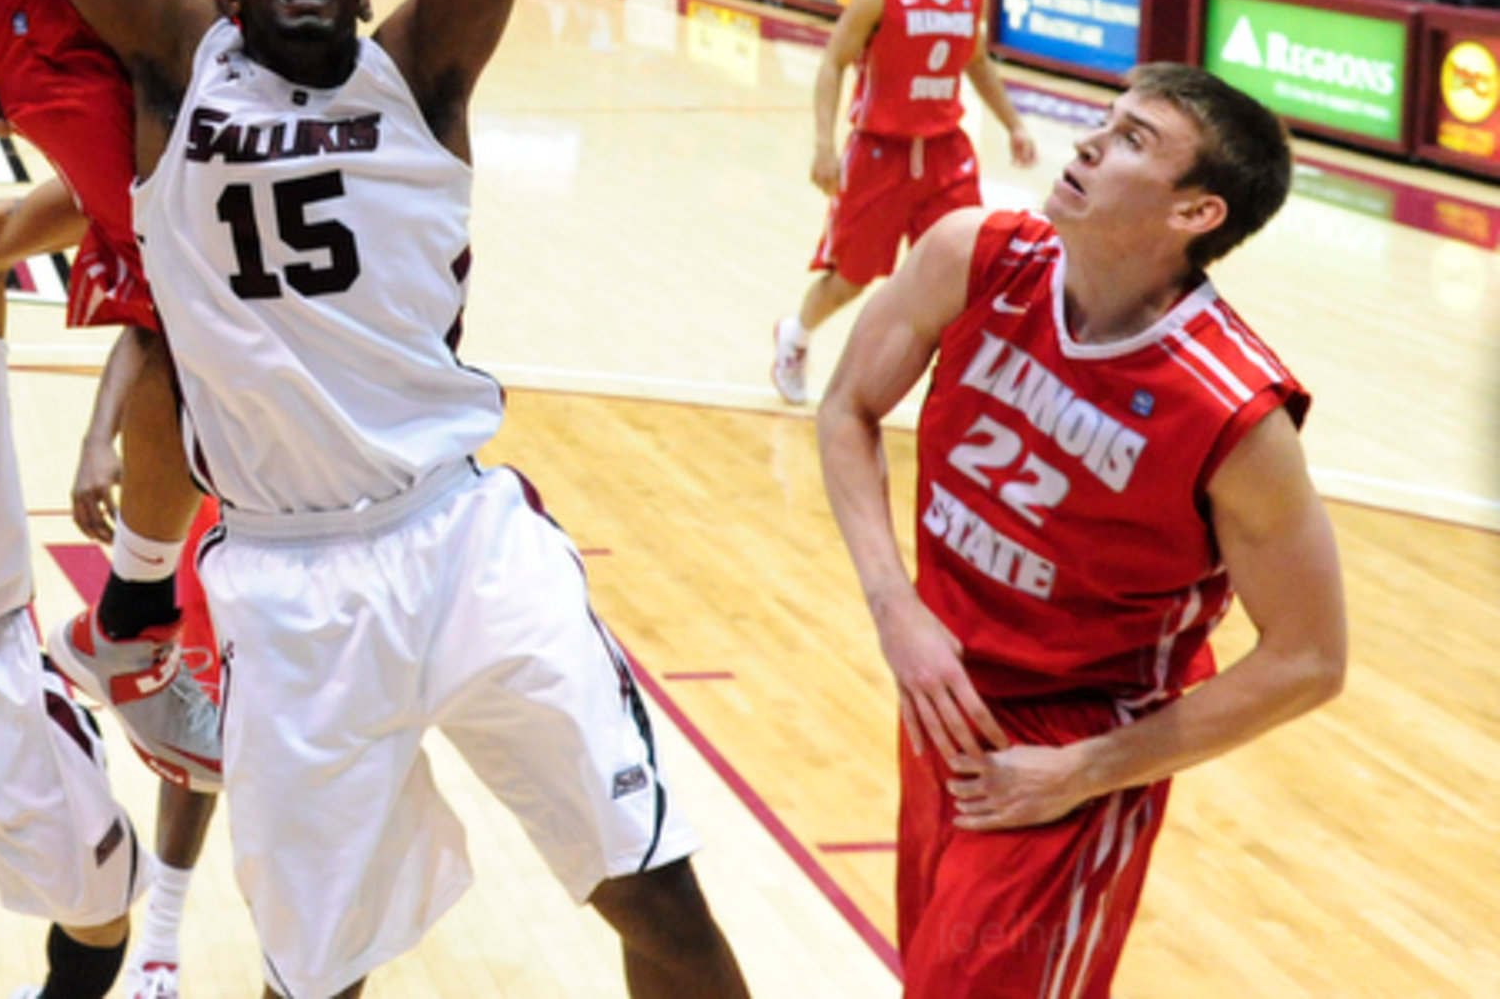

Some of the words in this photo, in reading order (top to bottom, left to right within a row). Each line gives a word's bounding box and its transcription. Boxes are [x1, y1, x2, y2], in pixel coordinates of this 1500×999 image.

[928, 41, 950, 71] 0
[185, 106, 382, 164] SALUKIS
[216, 169, 361, 300] 15
[946, 414, 1070, 528] 22
[922, 482, 1057, 601] STATE
